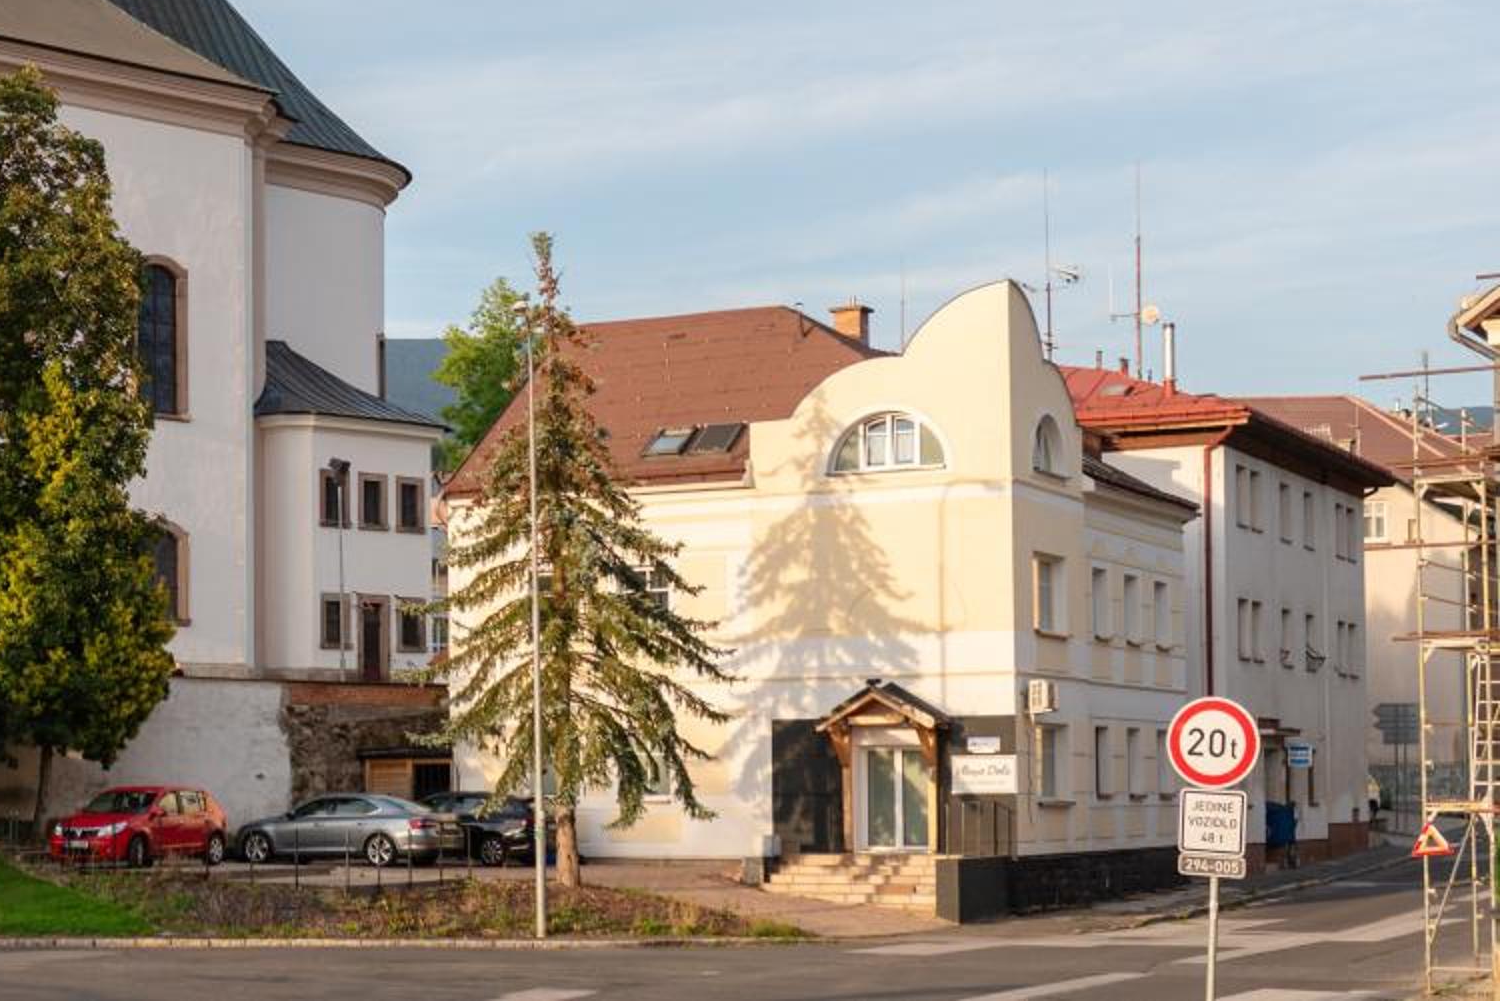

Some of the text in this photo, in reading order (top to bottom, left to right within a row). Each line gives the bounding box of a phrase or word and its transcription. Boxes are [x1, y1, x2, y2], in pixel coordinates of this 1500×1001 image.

[1187, 728, 1238, 760] 20 t
[1188, 815, 1237, 829] VOZIDLO
